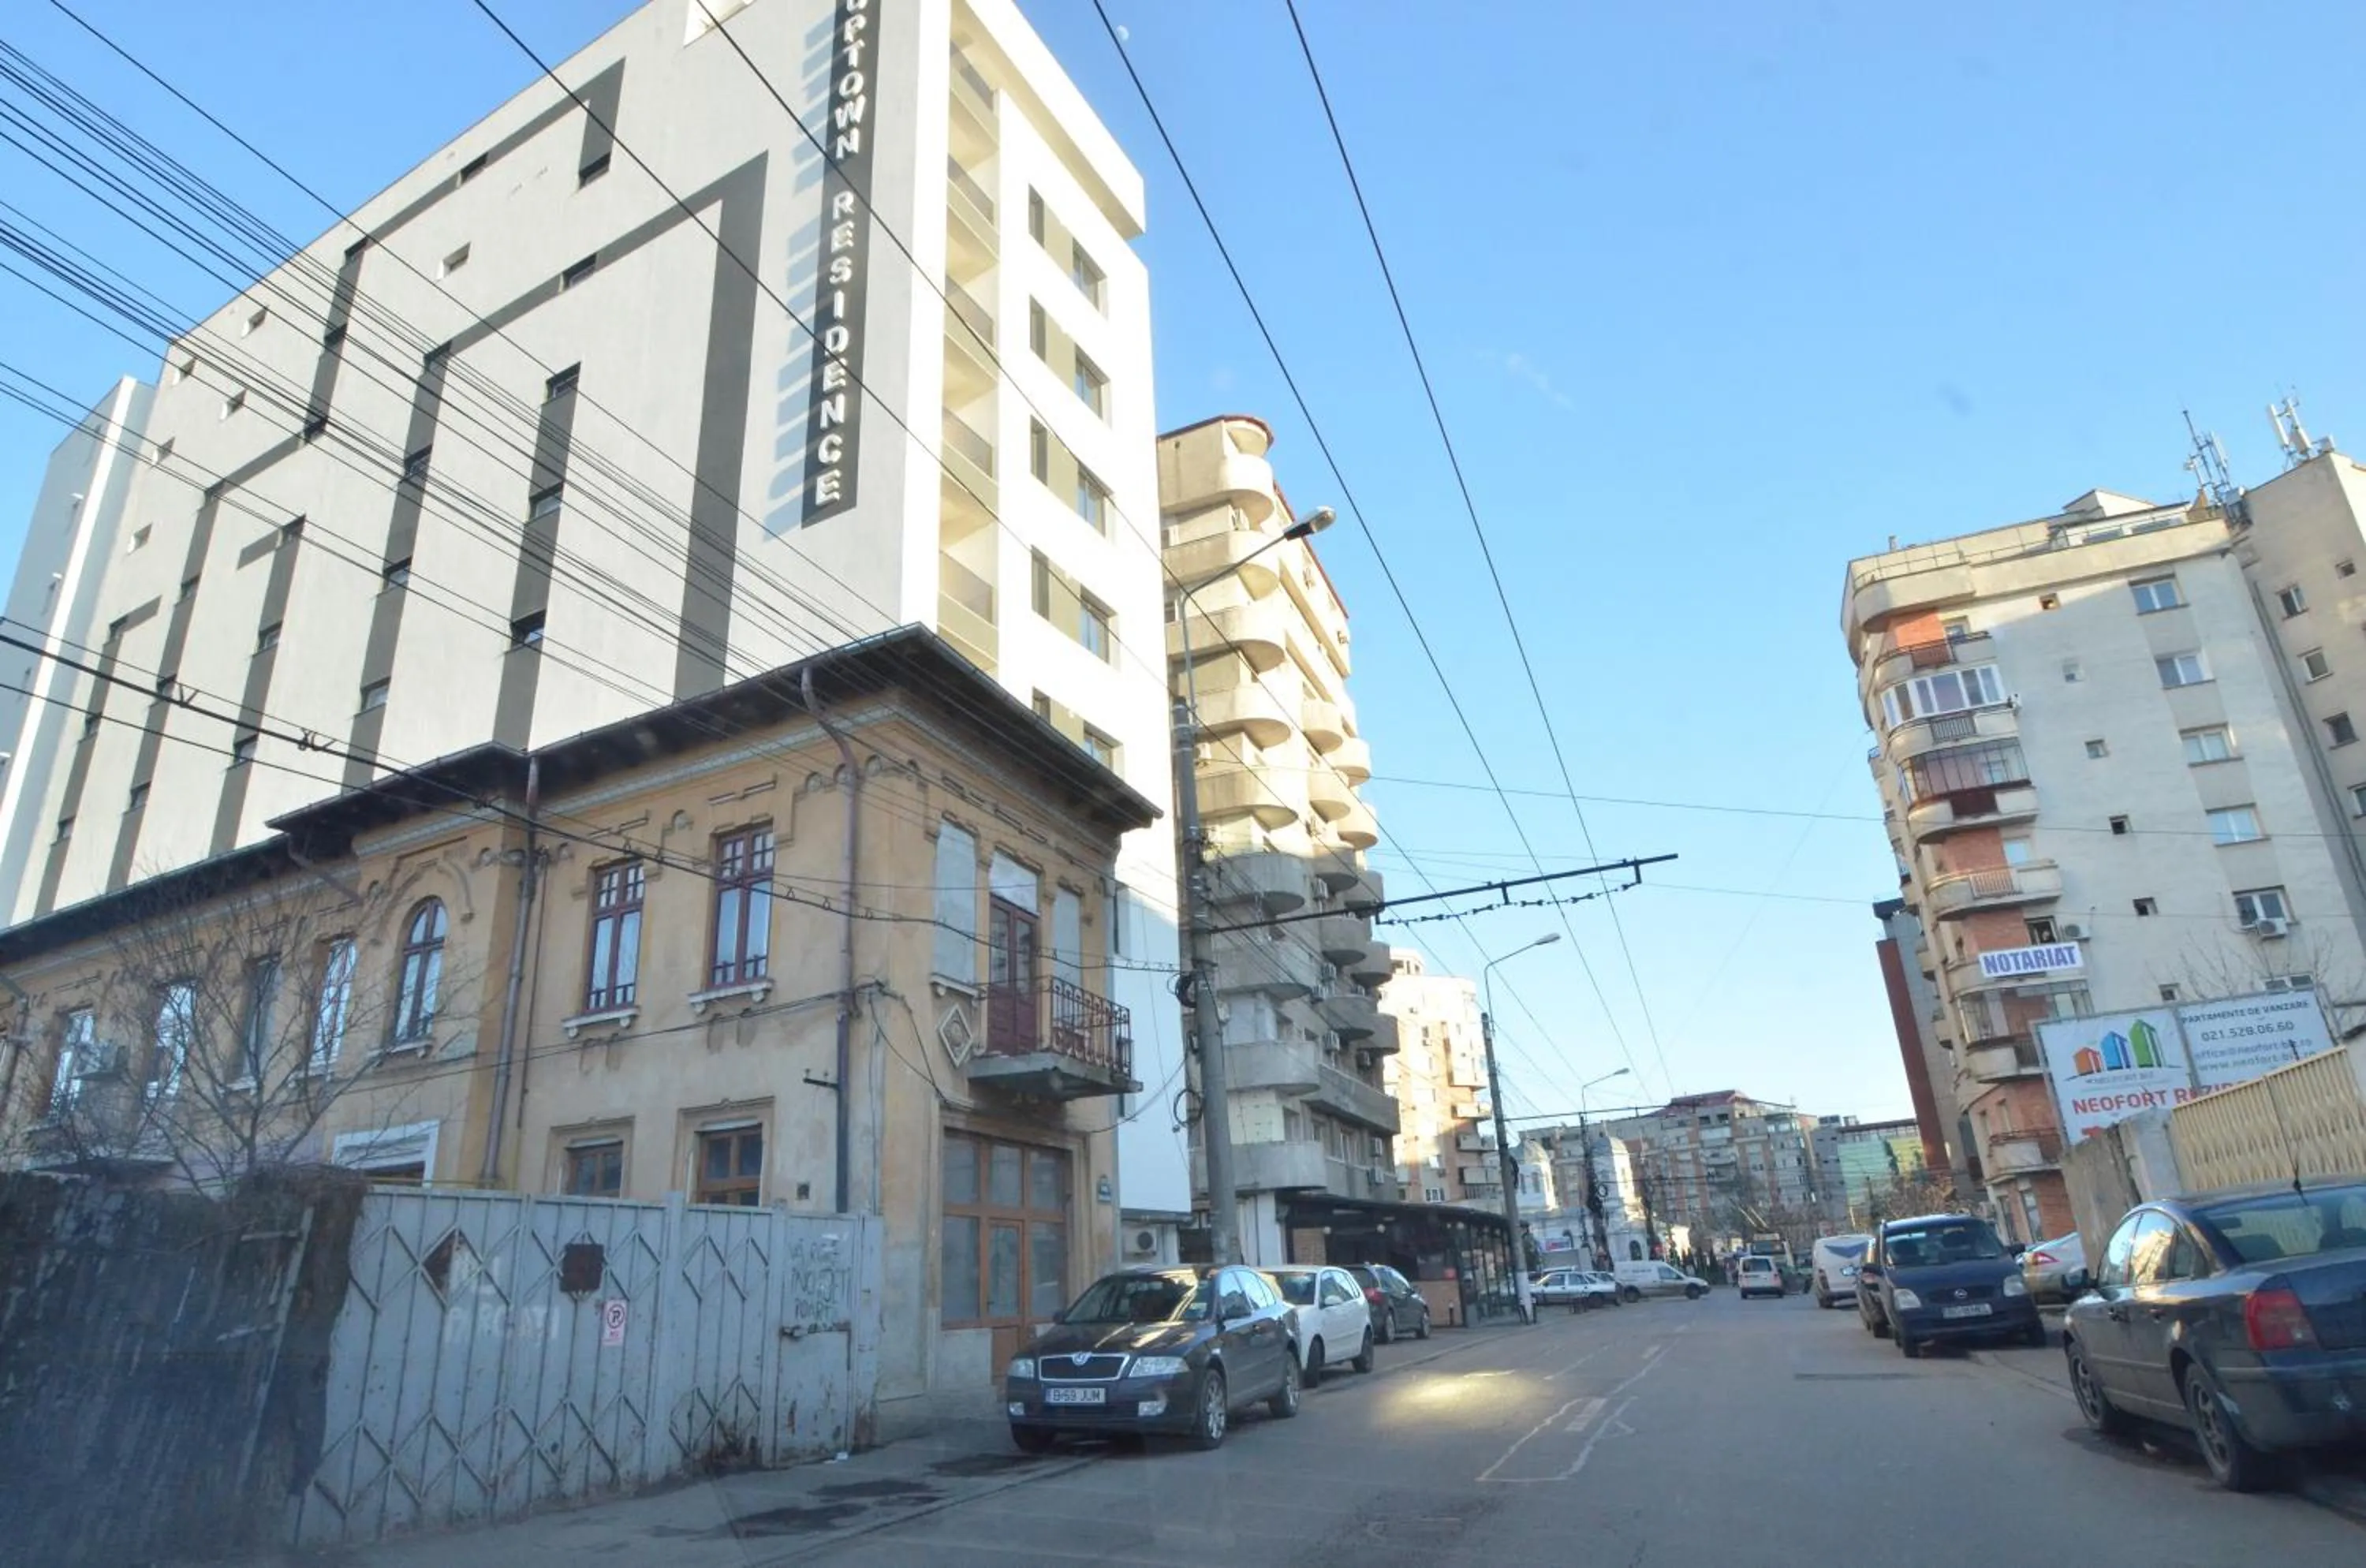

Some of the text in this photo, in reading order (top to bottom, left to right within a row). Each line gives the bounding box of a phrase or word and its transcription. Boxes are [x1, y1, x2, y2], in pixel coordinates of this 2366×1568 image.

[815, 190, 854, 506] RESIDENCE
[1983, 946, 2077, 974] NOTARIAT
[2181, 1010, 2246, 1025] PARTAMENTE
[2071, 1089, 2167, 1114] NEOFORT
